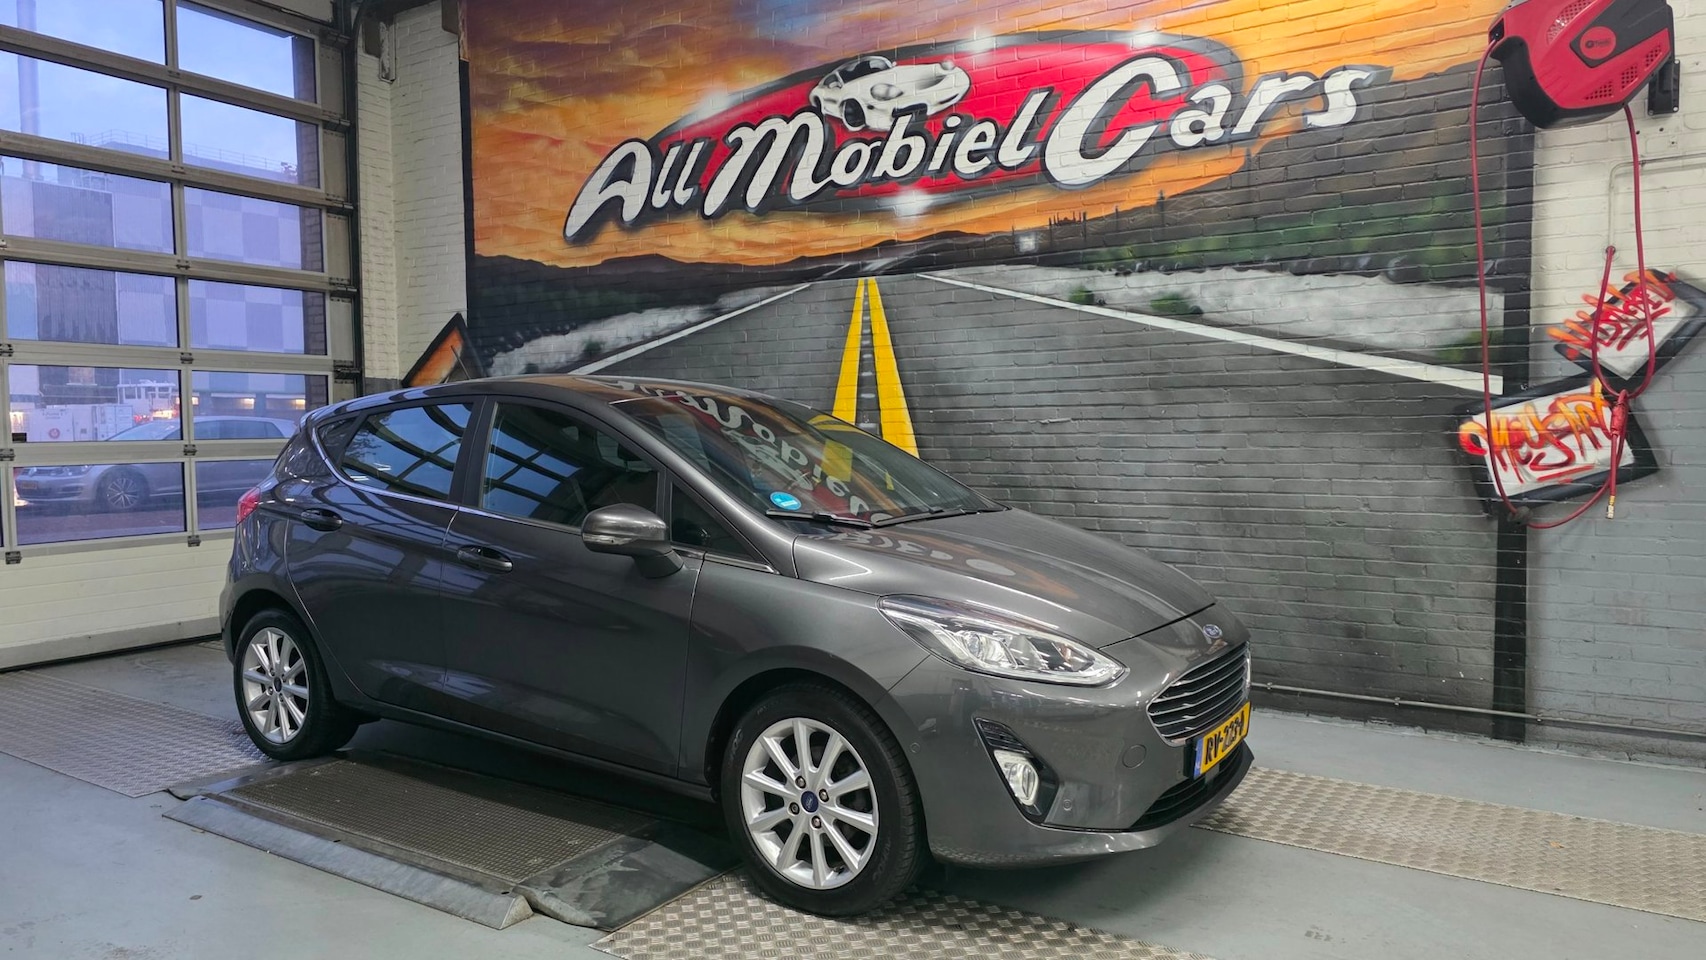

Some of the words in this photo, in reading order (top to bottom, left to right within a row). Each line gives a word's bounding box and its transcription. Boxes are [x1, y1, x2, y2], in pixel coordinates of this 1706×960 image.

[563, 139, 705, 239] All
[702, 90, 1050, 218] Mobiel
[1043, 55, 1374, 187] Cars
